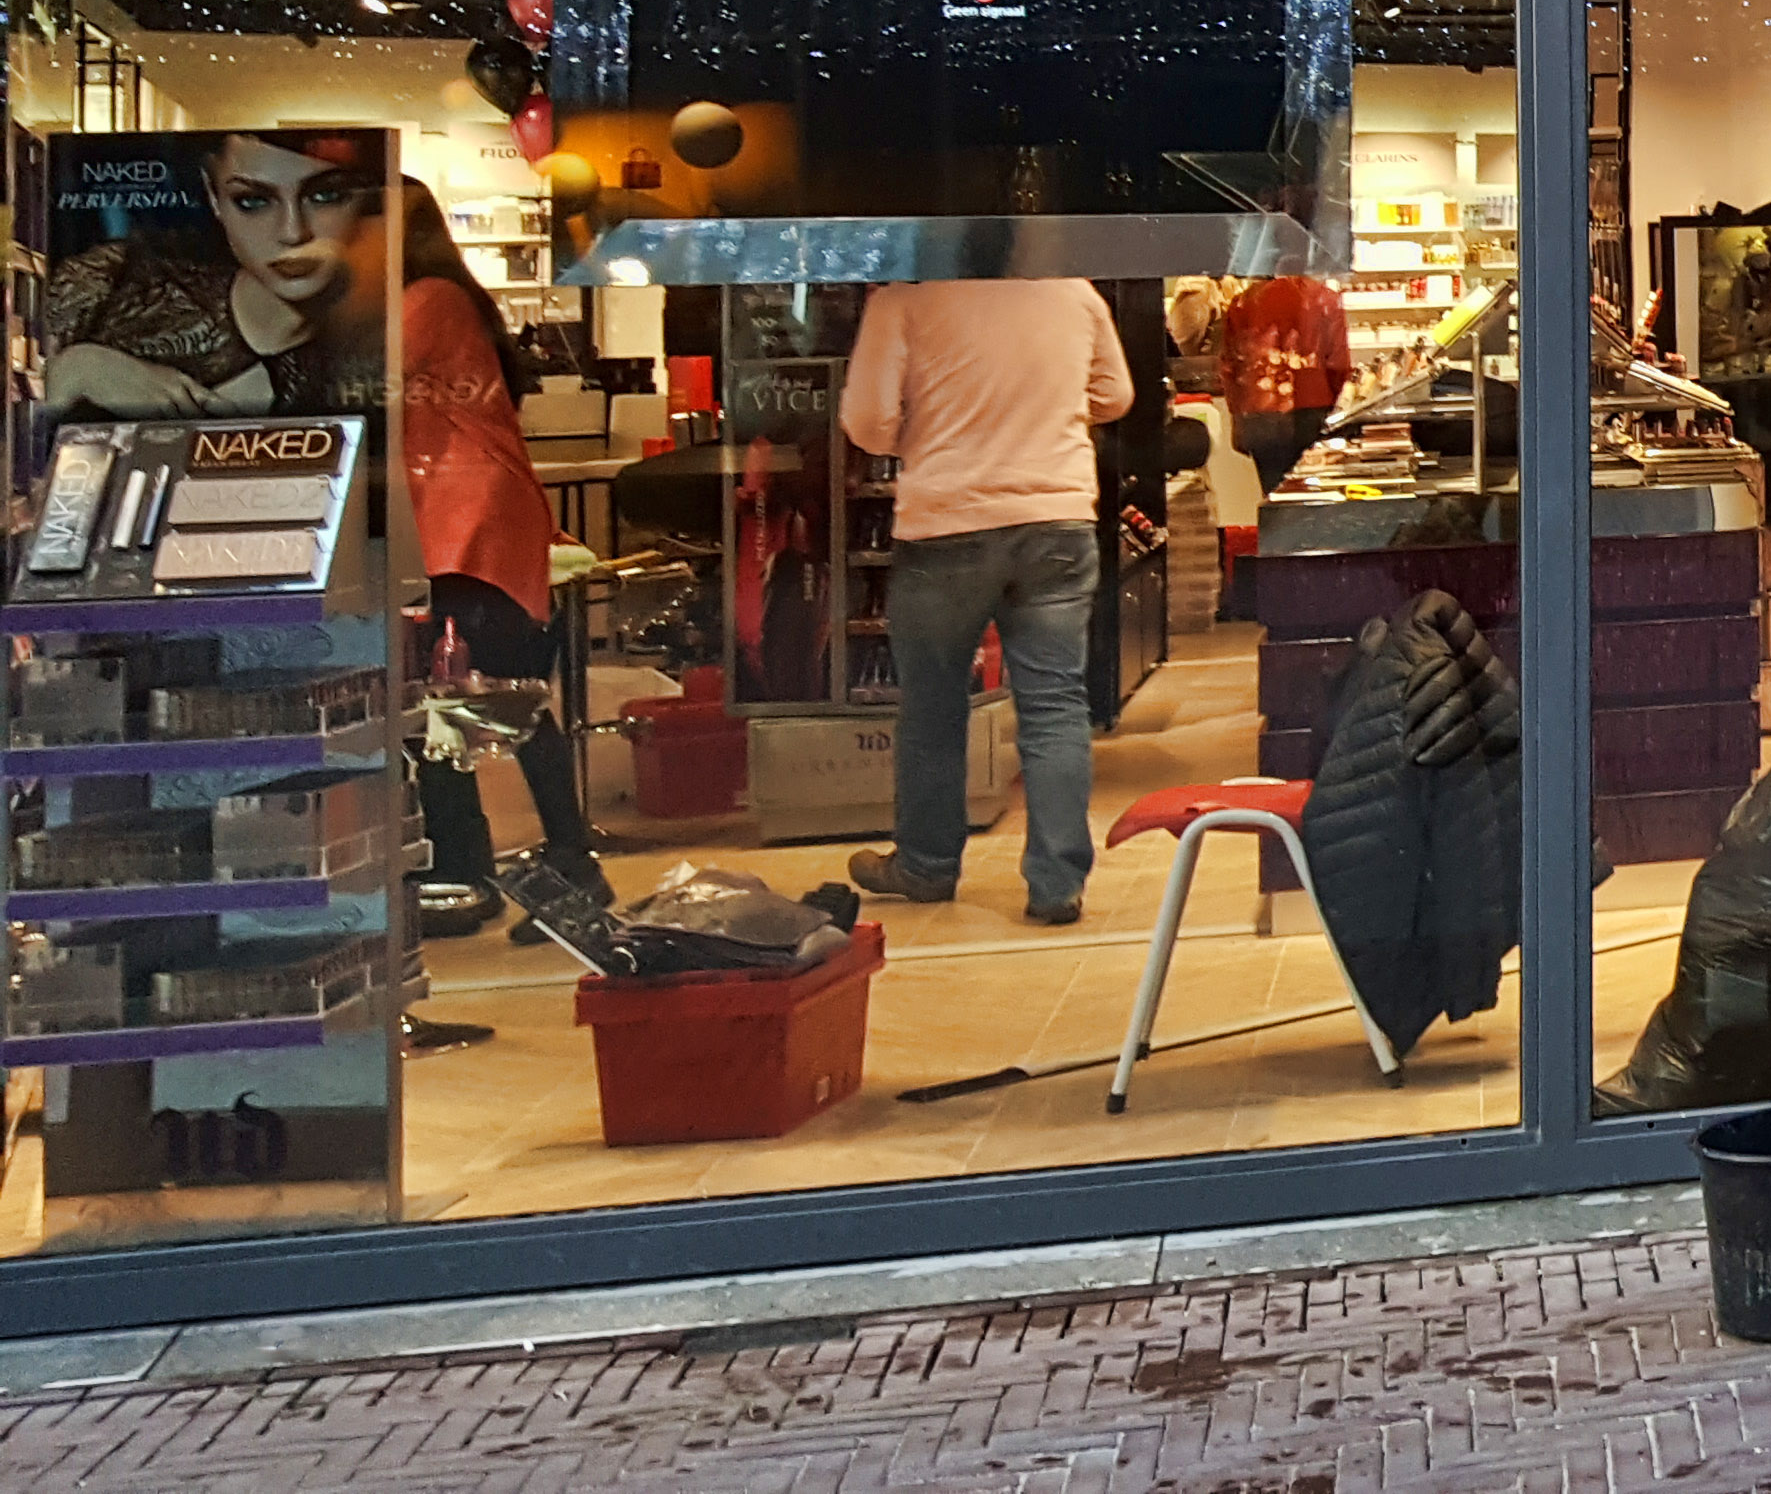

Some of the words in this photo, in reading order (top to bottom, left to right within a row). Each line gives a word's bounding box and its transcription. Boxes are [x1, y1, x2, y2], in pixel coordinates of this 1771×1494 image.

[941, 4, 979, 19] Geen
[480, 147, 518, 159] FILO
[1354, 153, 1419, 163] CLARINS
[83, 161, 168, 183] NAKED
[752, 390, 826, 411] VICE
[193, 429, 333, 463] NAKED
[38, 458, 92, 557] NAKED
